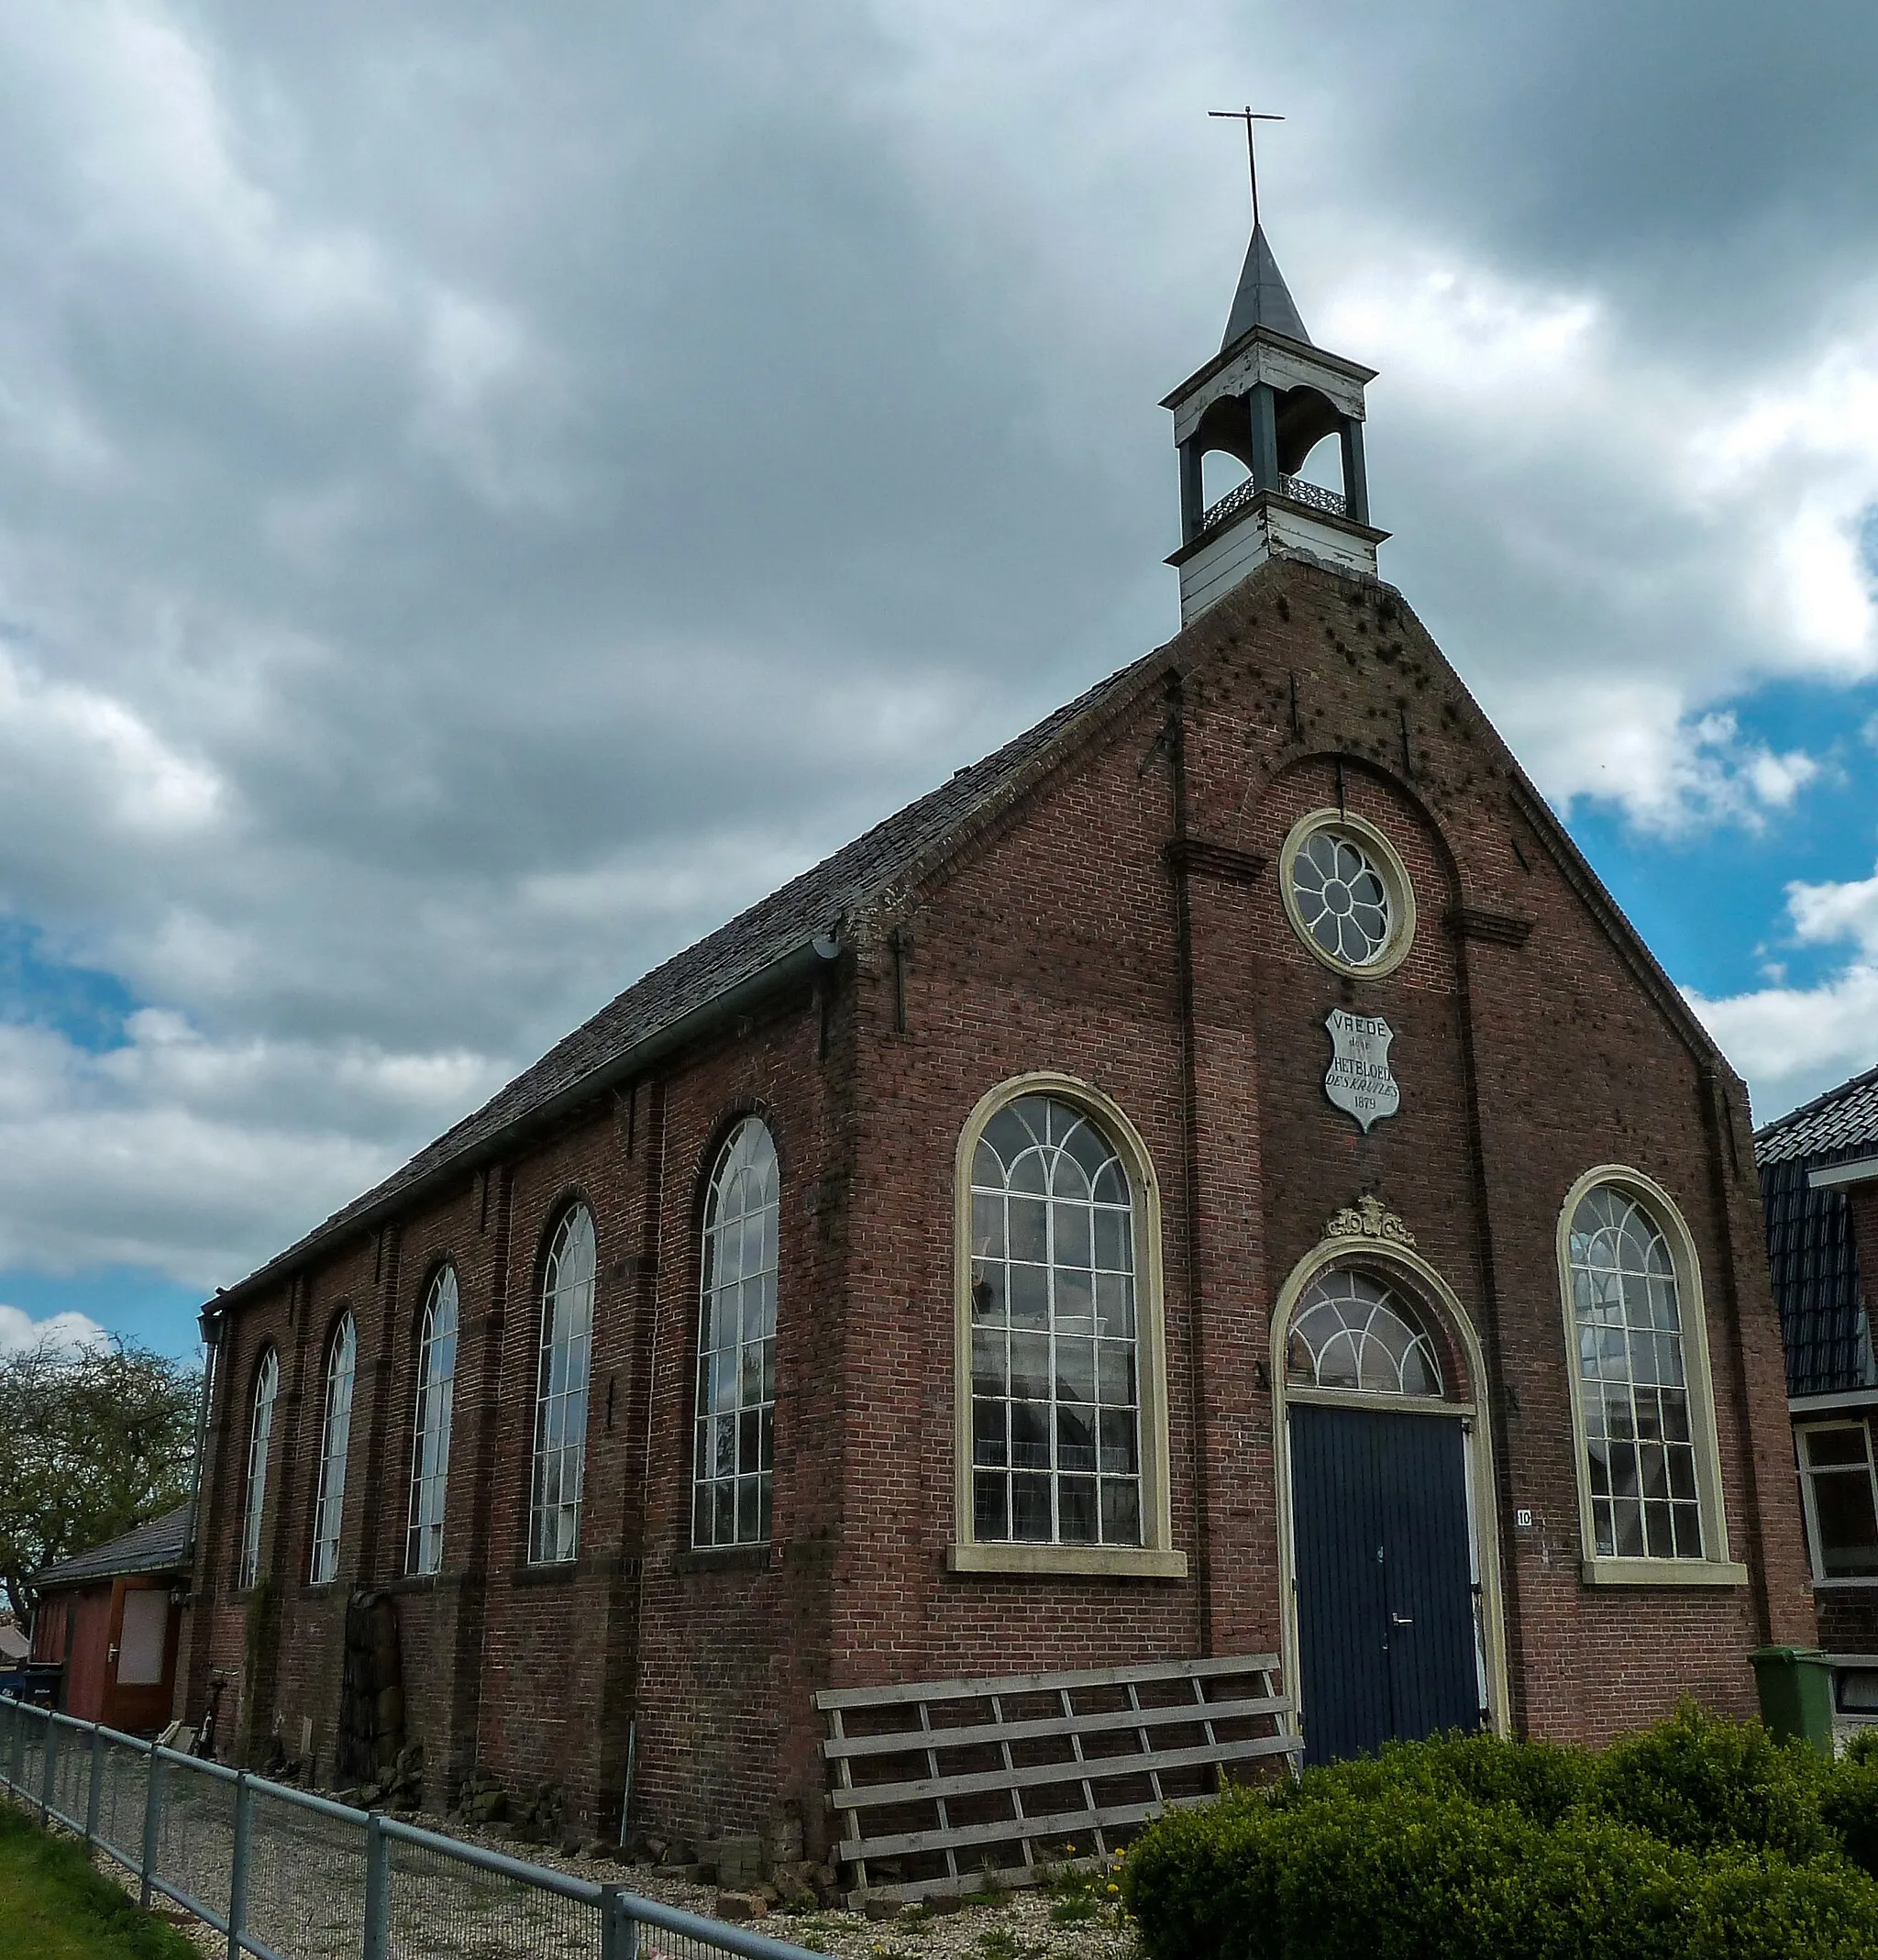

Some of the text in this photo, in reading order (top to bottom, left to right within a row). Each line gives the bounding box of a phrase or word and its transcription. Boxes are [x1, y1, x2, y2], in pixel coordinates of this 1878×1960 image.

[1332, 1013, 1386, 1036] VREDE
[1334, 1057, 1391, 1080] HET BLOED
[1326, 1074, 1349, 1087] DES
[1354, 1096, 1375, 1109] 1879
[1519, 1512, 1530, 1523] 10
